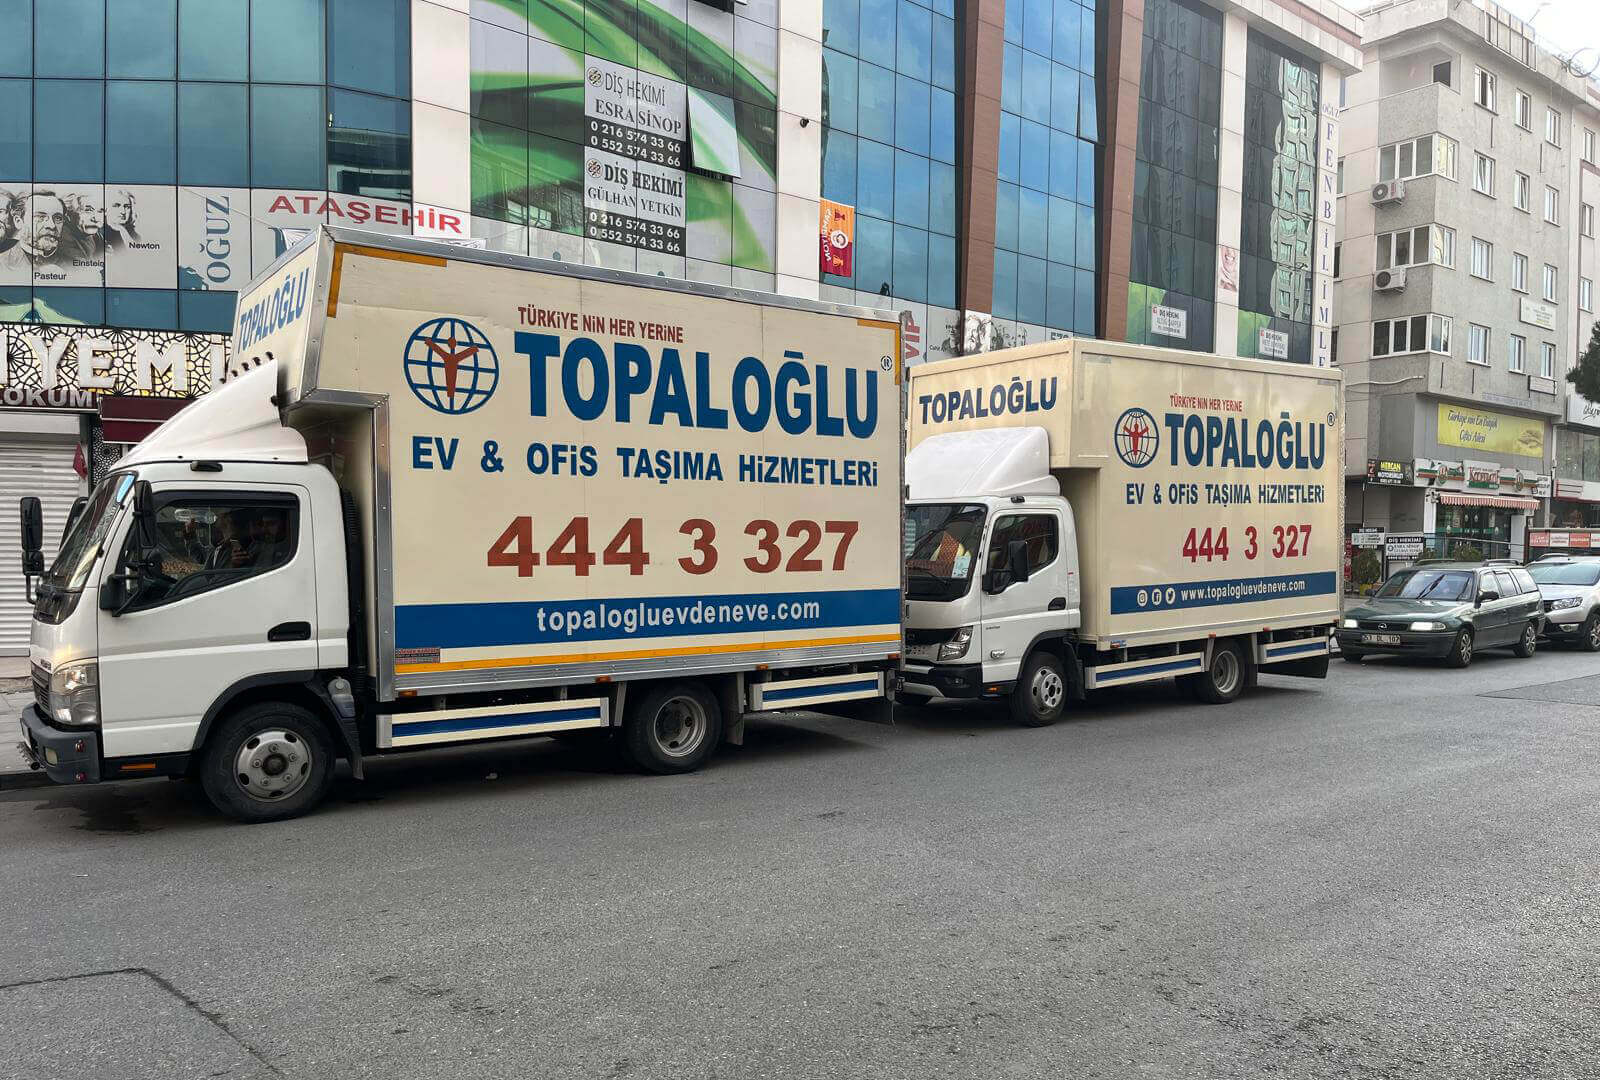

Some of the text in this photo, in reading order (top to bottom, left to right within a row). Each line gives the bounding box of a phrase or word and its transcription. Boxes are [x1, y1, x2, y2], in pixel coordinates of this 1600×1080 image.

[605, 72, 665, 106] DİŞ HEKİMİ
[595, 99, 681, 134] ESRA SİNOP
[591, 121, 680, 153] 0 216 574 33 66
[591, 136, 680, 167] 0 552 574 33 66
[604, 162, 683, 198] DİŞ HEKİMİ
[268, 195, 462, 234] ATAŞEHİR
[588, 186, 681, 217] GÜLHAN YETKİN
[200, 195, 231, 283] OĞUZ
[590, 212, 680, 239] 0 216 574 33 66
[590, 227, 680, 253] 0 552 574 33 66
[129, 241, 160, 250] Newton
[34, 272, 67, 281] Pasteur
[73, 259, 105, 267] Einstein
[238, 268, 309, 353] TOPALOĞLU
[609, 320, 636, 338] HER
[514, 331, 878, 439] TOPALOĞLU
[919, 376, 1057, 425] TOPALOĞLU
[1209, 399, 1221, 411] HER
[1165, 411, 1325, 470] TOPALOĞLU
[411, 435, 458, 471] EV
[480, 440, 504, 473] &
[616, 447, 723, 485] TAŞIMA
[1126, 483, 1145, 505] EV
[1153, 483, 1162, 505] &
[1205, 484, 1251, 507] TAŞIMA
[487, 516, 859, 577] 444 3 327
[1183, 526, 1229, 563] 444
[1244, 525, 1258, 560] 3
[1272, 524, 1312, 559] 327
[1181, 579, 1305, 601] www.topalogluevdeneve.com
[537, 600, 820, 635] topalogluevdeneve.com
